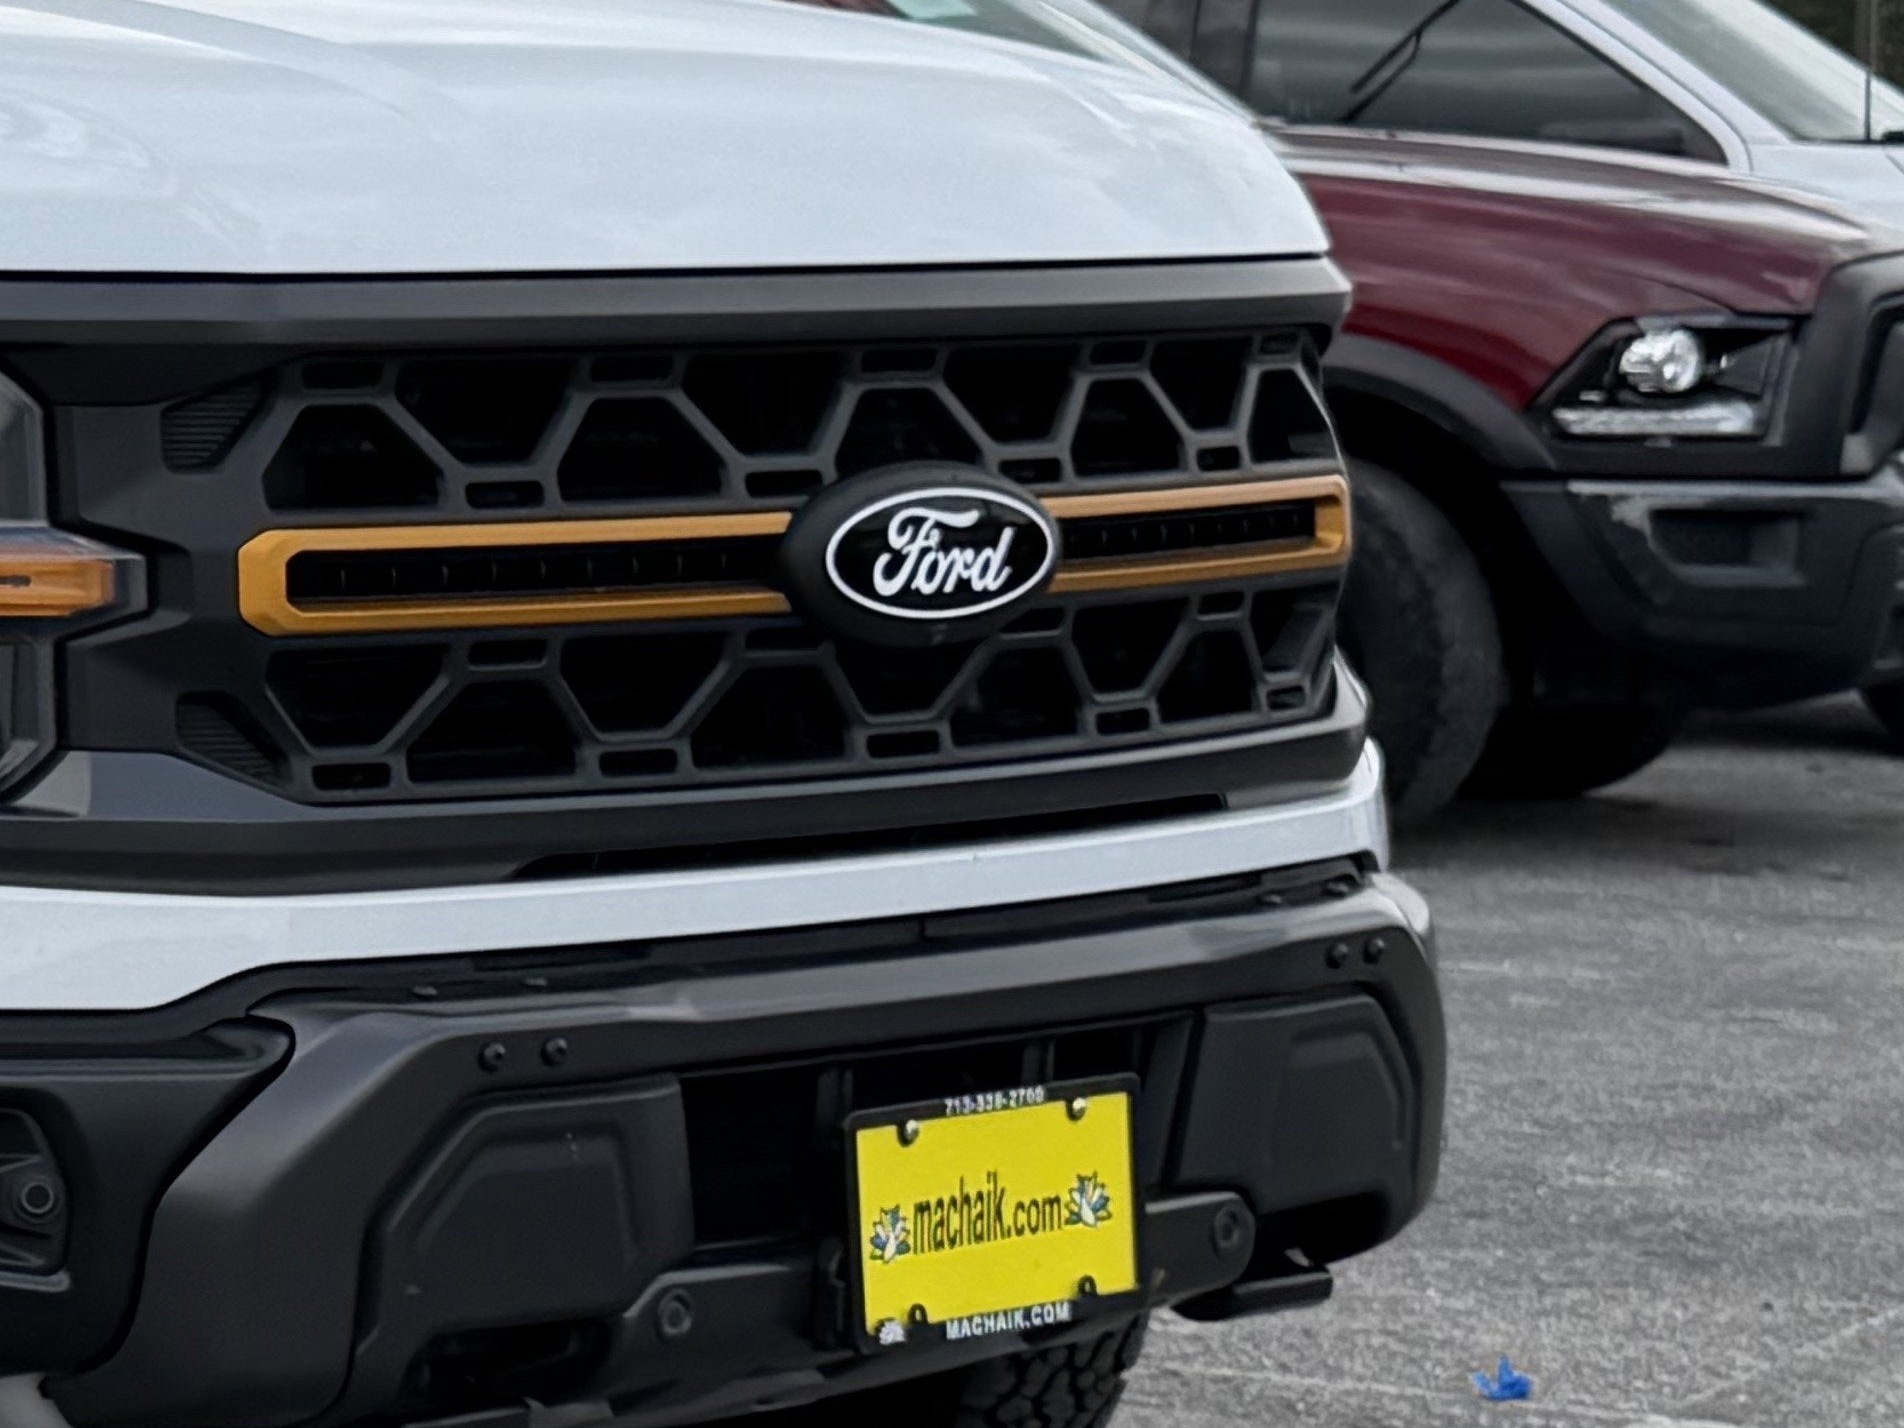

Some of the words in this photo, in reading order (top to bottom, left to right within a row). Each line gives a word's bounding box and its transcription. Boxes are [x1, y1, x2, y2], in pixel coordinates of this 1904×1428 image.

[873, 507, 1015, 596] Ford
[913, 1171, 1061, 1254] machaik.com
[946, 1301, 1071, 1340] MACHAIK.COM
